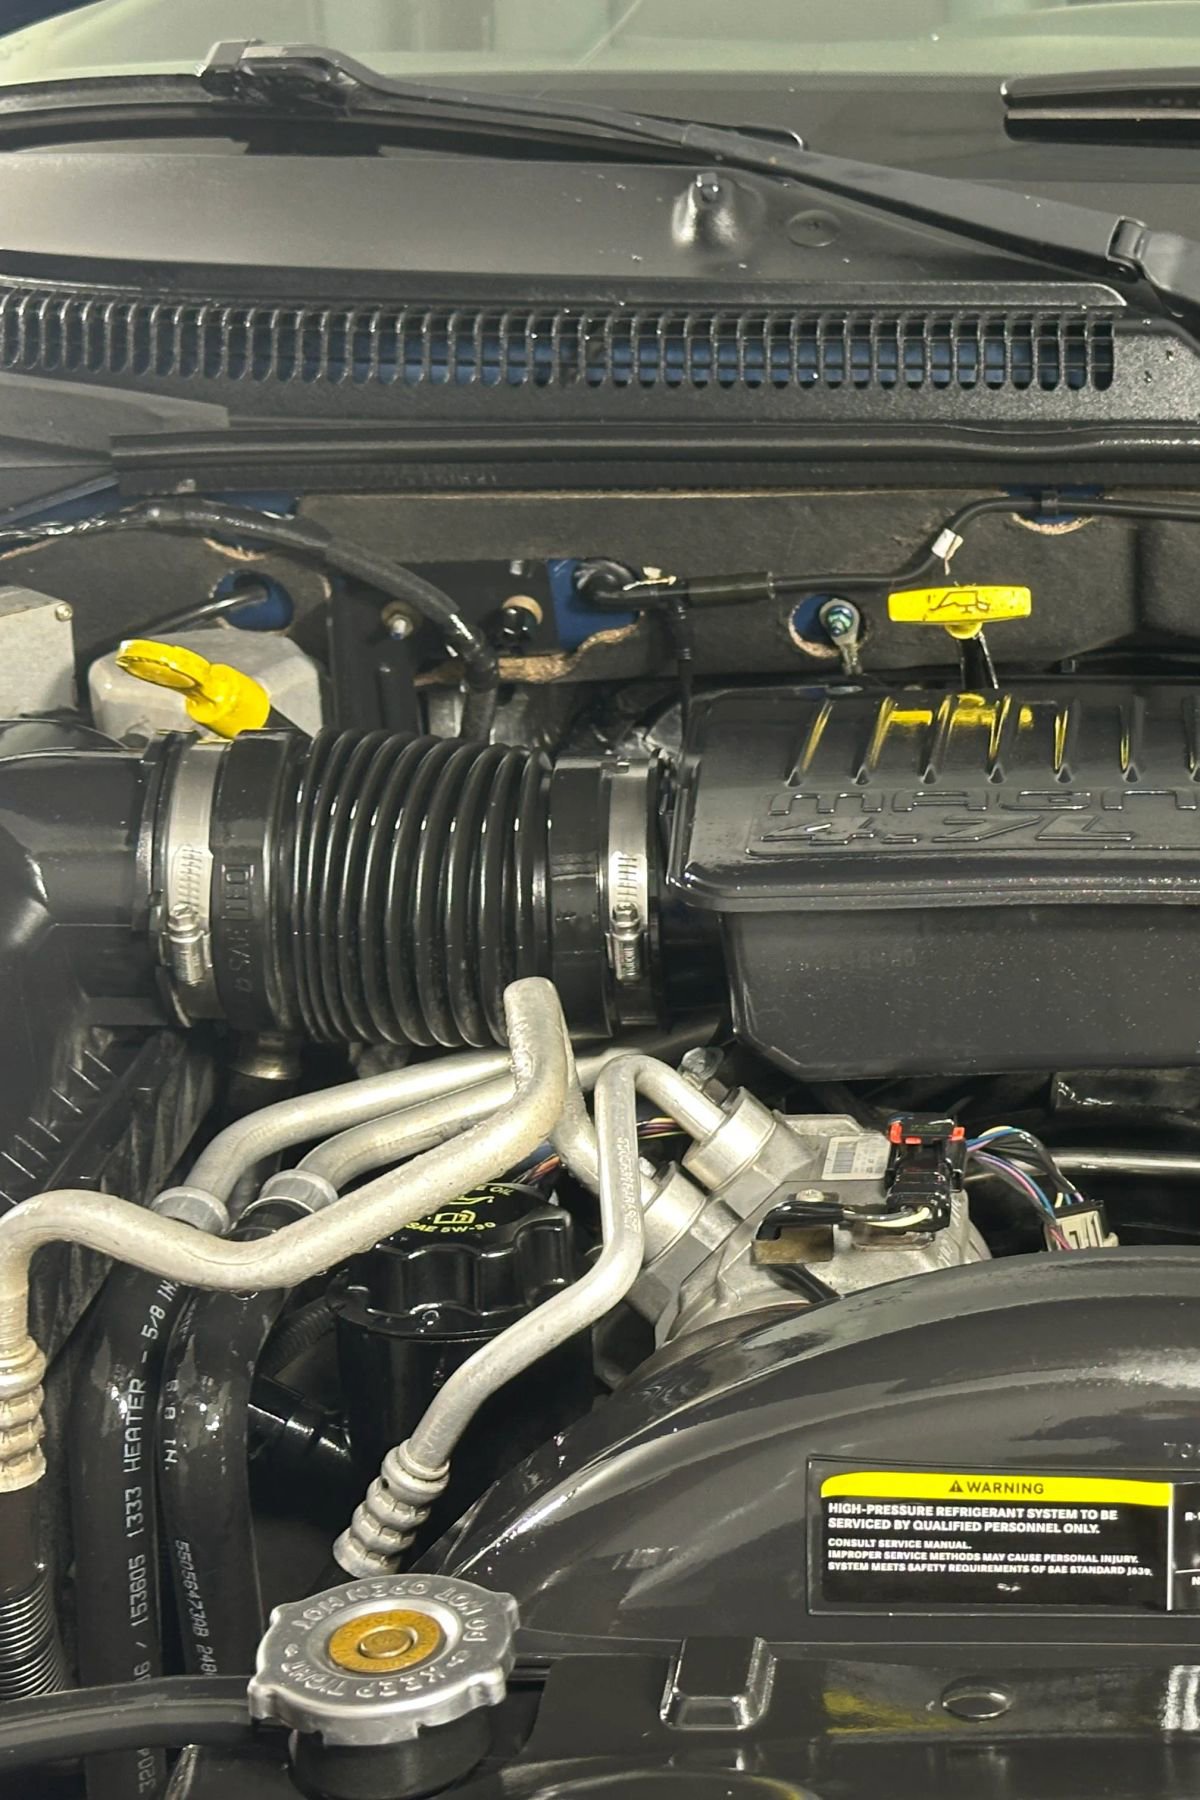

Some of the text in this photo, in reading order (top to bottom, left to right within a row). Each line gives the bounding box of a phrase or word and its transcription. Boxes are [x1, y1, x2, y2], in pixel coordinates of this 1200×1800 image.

[761, 815, 1134, 847] 4.7L
[405, 1221, 497, 1233] SAE 5W-30
[156, 1279, 180, 1302] IN.
[140, 1304, 166, 1340] 5/8
[123, 1378, 147, 1474] HEATER
[967, 1481, 1045, 1496] WARNING
[125, 1486, 144, 1538] 1333
[828, 1503, 1118, 1521] HIGH-PRESSURE REFRIGERANT SYSTEM TO BE
[828, 1518, 1100, 1533] SERVICED BY QUALIFIED PERSONNEL ONLY.
[828, 1538, 972, 1549] CONSULT SERVICE MANUAL.
[828, 1550, 1138, 1564] IMPROPER SERVICE METHODS MAY CAUSE PERSONAL INJURY.
[828, 1562, 870, 1571] SYSTEM
[872, 1563, 905, 1572] MEETS
[907, 1563, 946, 1572] SAFETY
[948, 1564, 1029, 1573] REQUIREMENTS
[1032, 1565, 1046, 1574] OF
[1048, 1565, 1068, 1574] SAE
[1070, 1565, 1125, 1574] STANDARD
[128, 1554, 149, 1627] 153605
[346, 1580, 432, 1602] OPEN
[434, 1586, 490, 1616] NOT
[462, 1618, 489, 1643] DO
[281, 1663, 446, 1698] KEEP TIGHT
